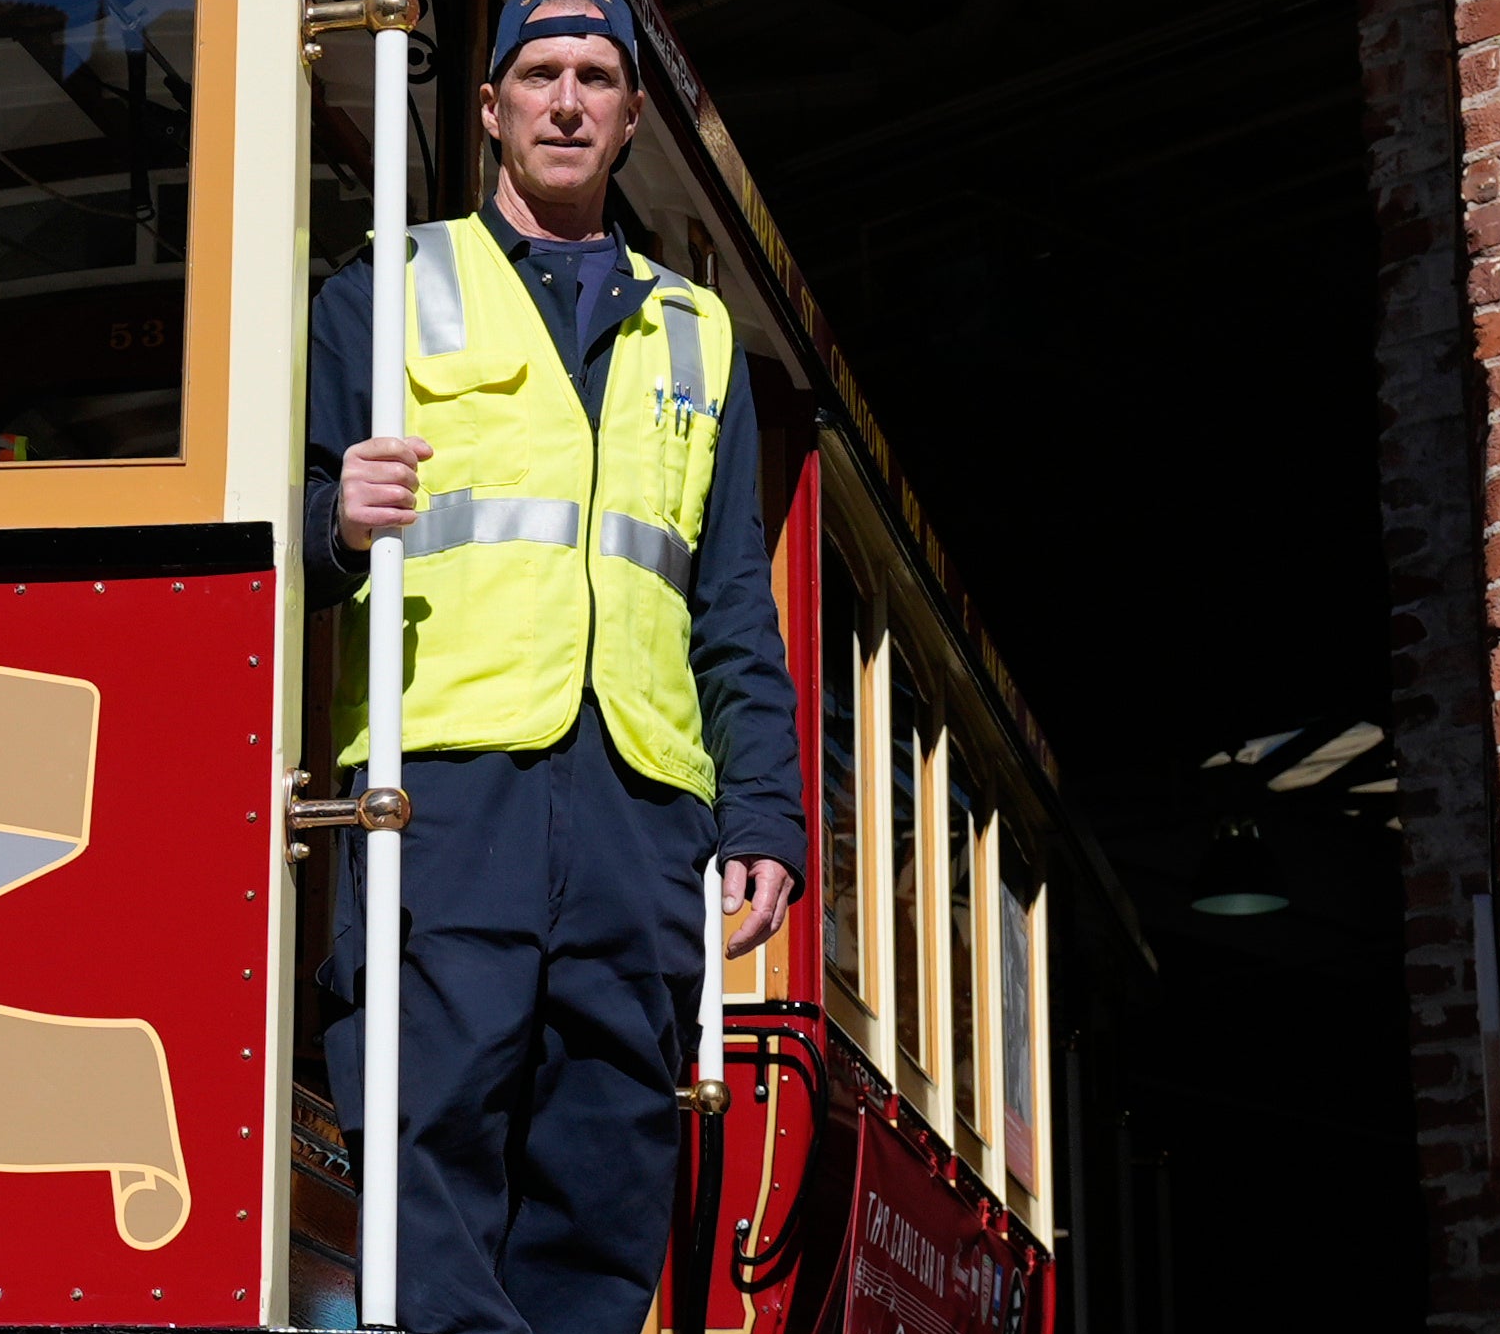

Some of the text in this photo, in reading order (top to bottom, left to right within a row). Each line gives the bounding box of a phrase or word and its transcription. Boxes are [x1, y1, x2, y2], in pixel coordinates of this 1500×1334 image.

[741, 166, 791, 298] MARKET
[800, 285, 815, 338] ST
[108, 317, 167, 351] 53
